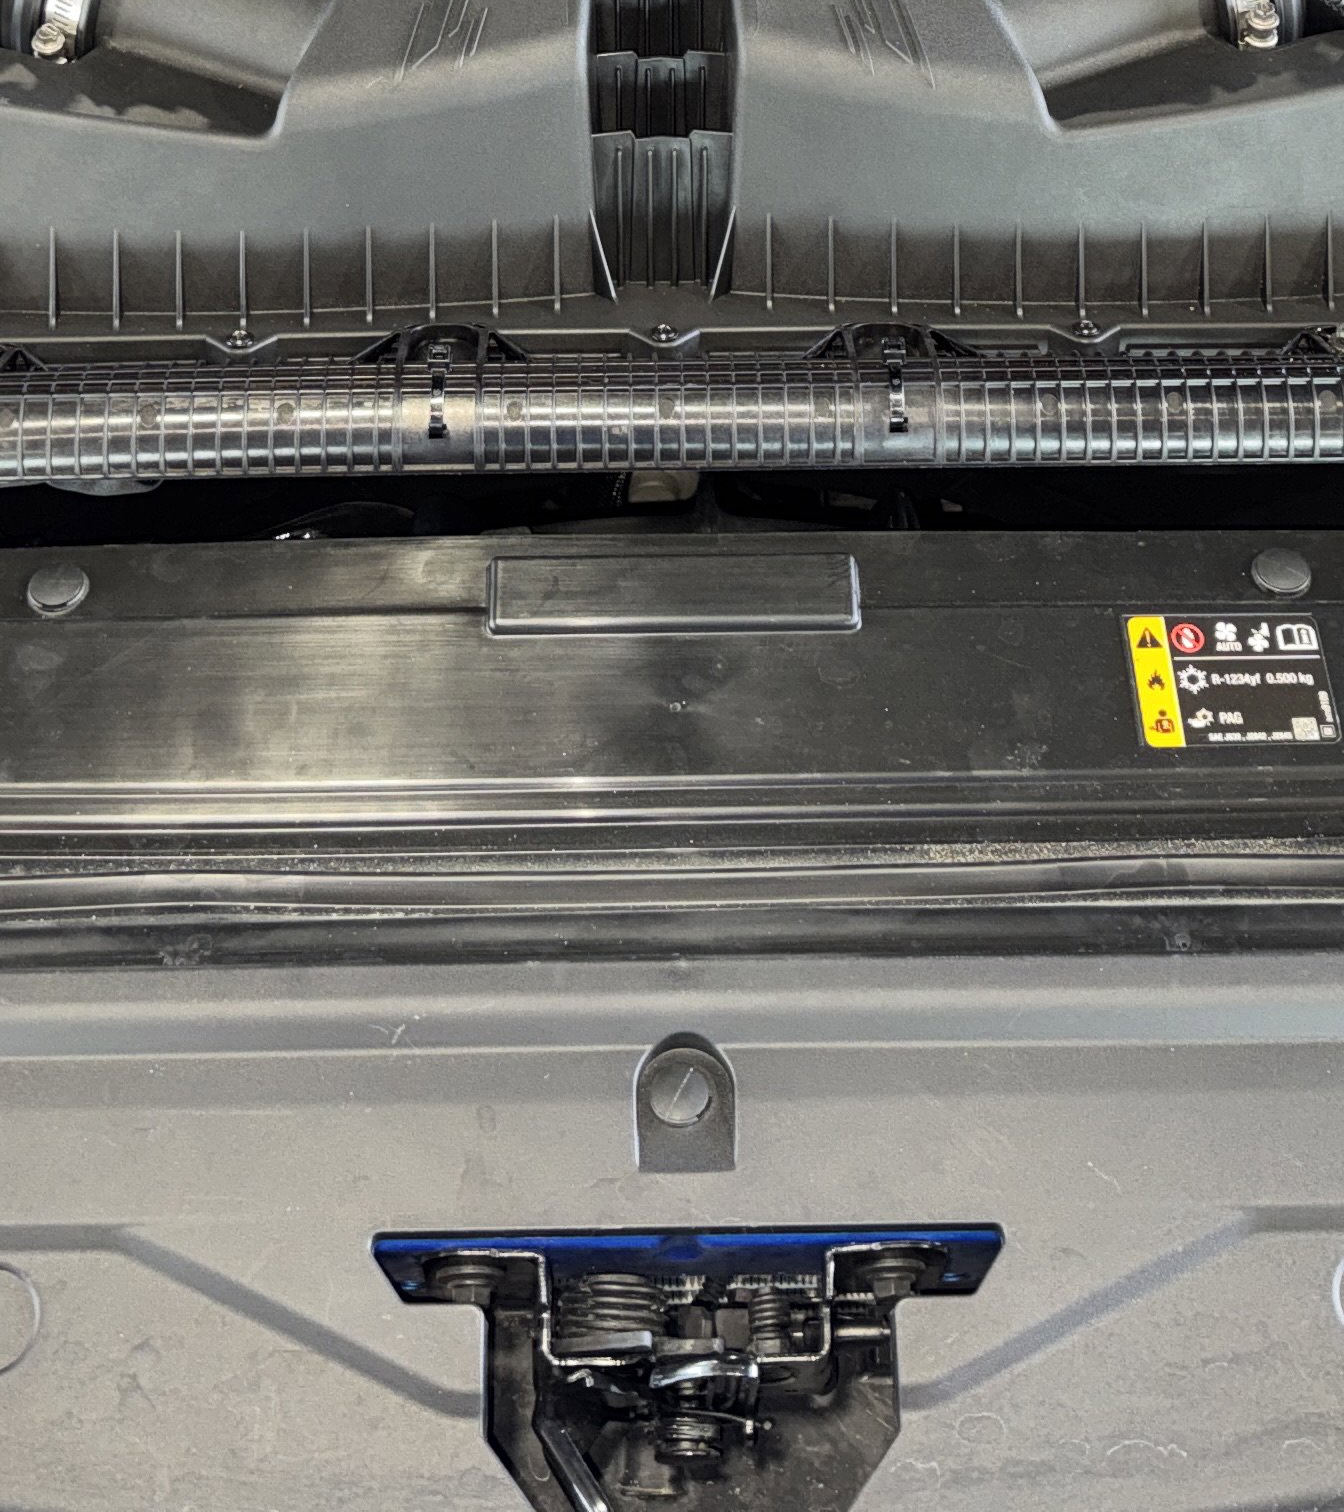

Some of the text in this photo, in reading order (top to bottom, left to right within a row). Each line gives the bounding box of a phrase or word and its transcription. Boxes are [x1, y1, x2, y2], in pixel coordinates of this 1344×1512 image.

[1215, 641, 1242, 652] AUTO
[1210, 671, 1315, 686] R-1234yf 0.500 kg
[1218, 711, 1244, 725] PAG
